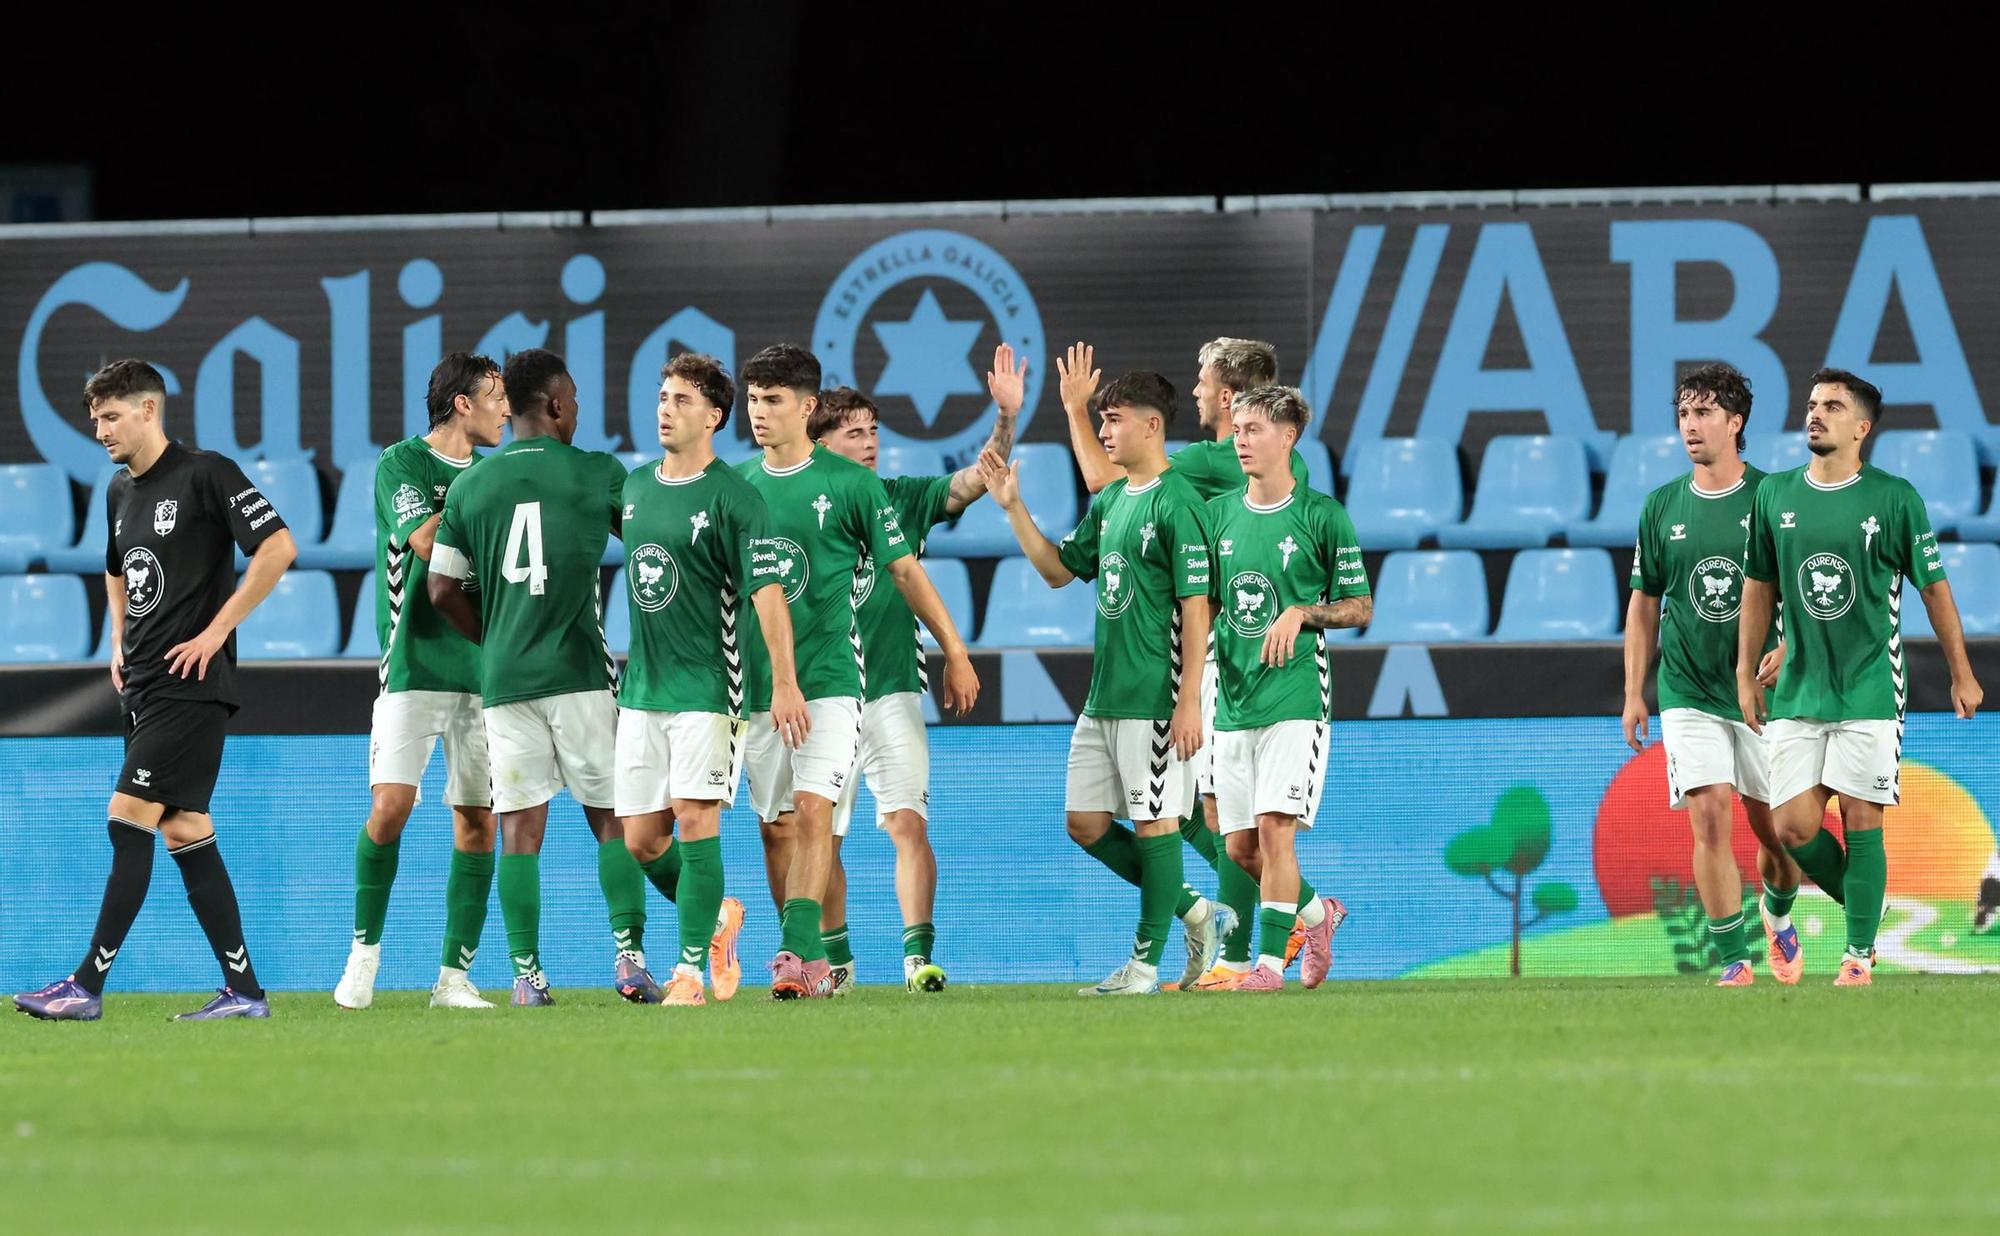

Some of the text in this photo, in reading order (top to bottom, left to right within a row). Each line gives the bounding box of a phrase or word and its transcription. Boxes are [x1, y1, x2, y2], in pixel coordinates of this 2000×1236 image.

[833, 246, 1022, 321] ESTRELLA GALICIA
[241, 497, 269, 518] Siweb
[396, 506, 433, 529] ABANCA
[501, 501, 548, 596] 4
[635, 546, 670, 566] OURENSE
[751, 550, 777, 563] Siweb
[124, 550, 153, 569] OURENSE
[1337, 559, 1362, 571] Siweb
[1697, 559, 1737, 576] OURENSE
[1807, 555, 1848, 574] OURENSE
[1232, 574, 1270, 592] OURENSE
